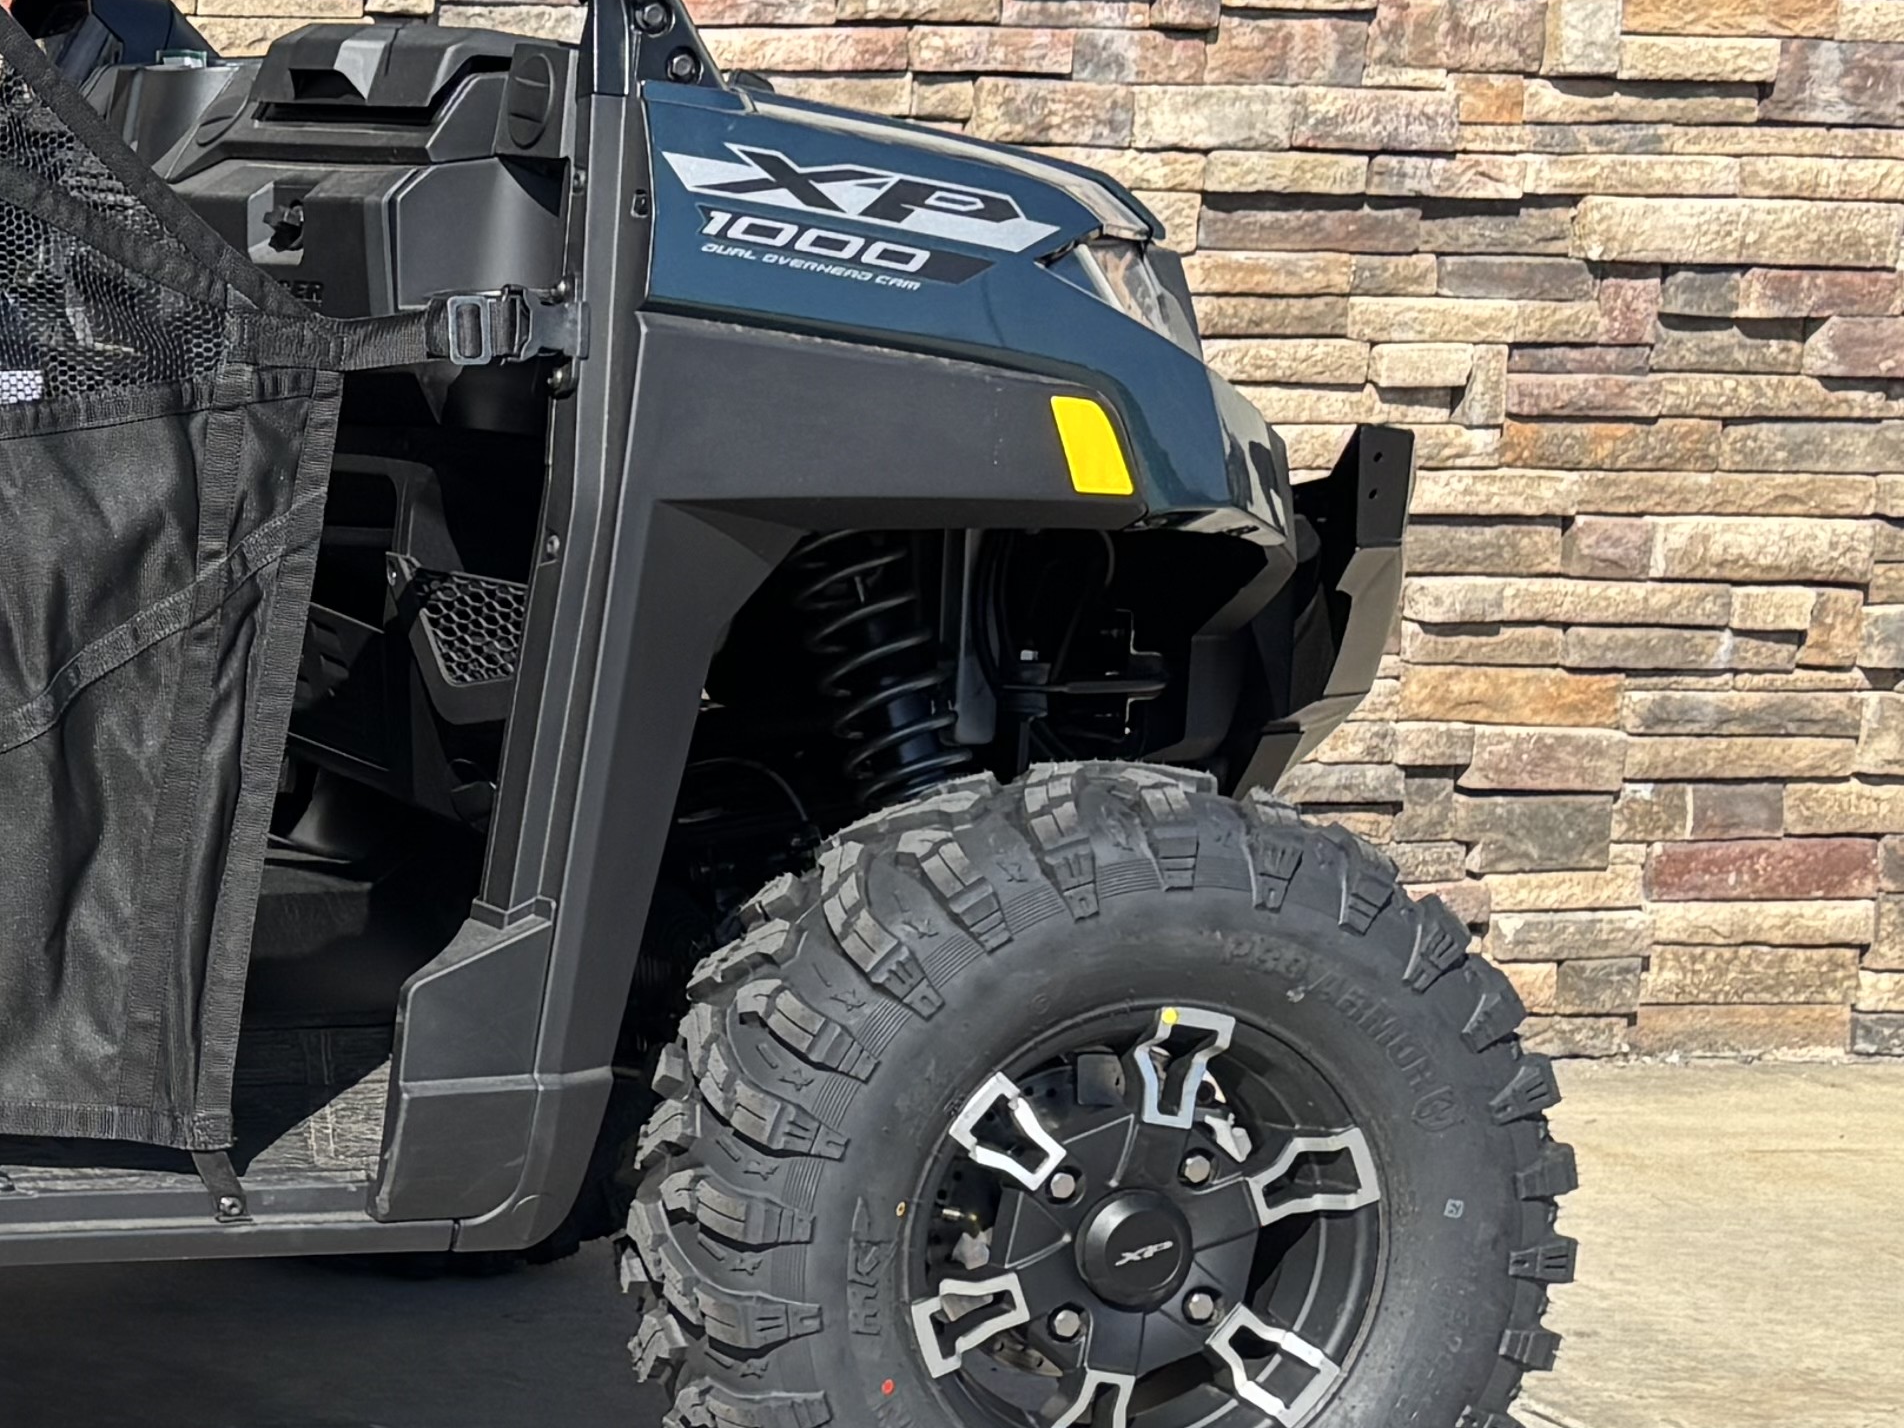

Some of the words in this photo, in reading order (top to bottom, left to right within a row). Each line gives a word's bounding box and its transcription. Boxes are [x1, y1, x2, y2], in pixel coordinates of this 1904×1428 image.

[690, 143, 1028, 225] XP
[701, 210, 931, 273] 1000
[701, 243, 757, 261] DUAL
[762, 251, 873, 285] OVERHEAD
[875, 274, 922, 292] CAM
[1115, 1240, 1174, 1267] XP
